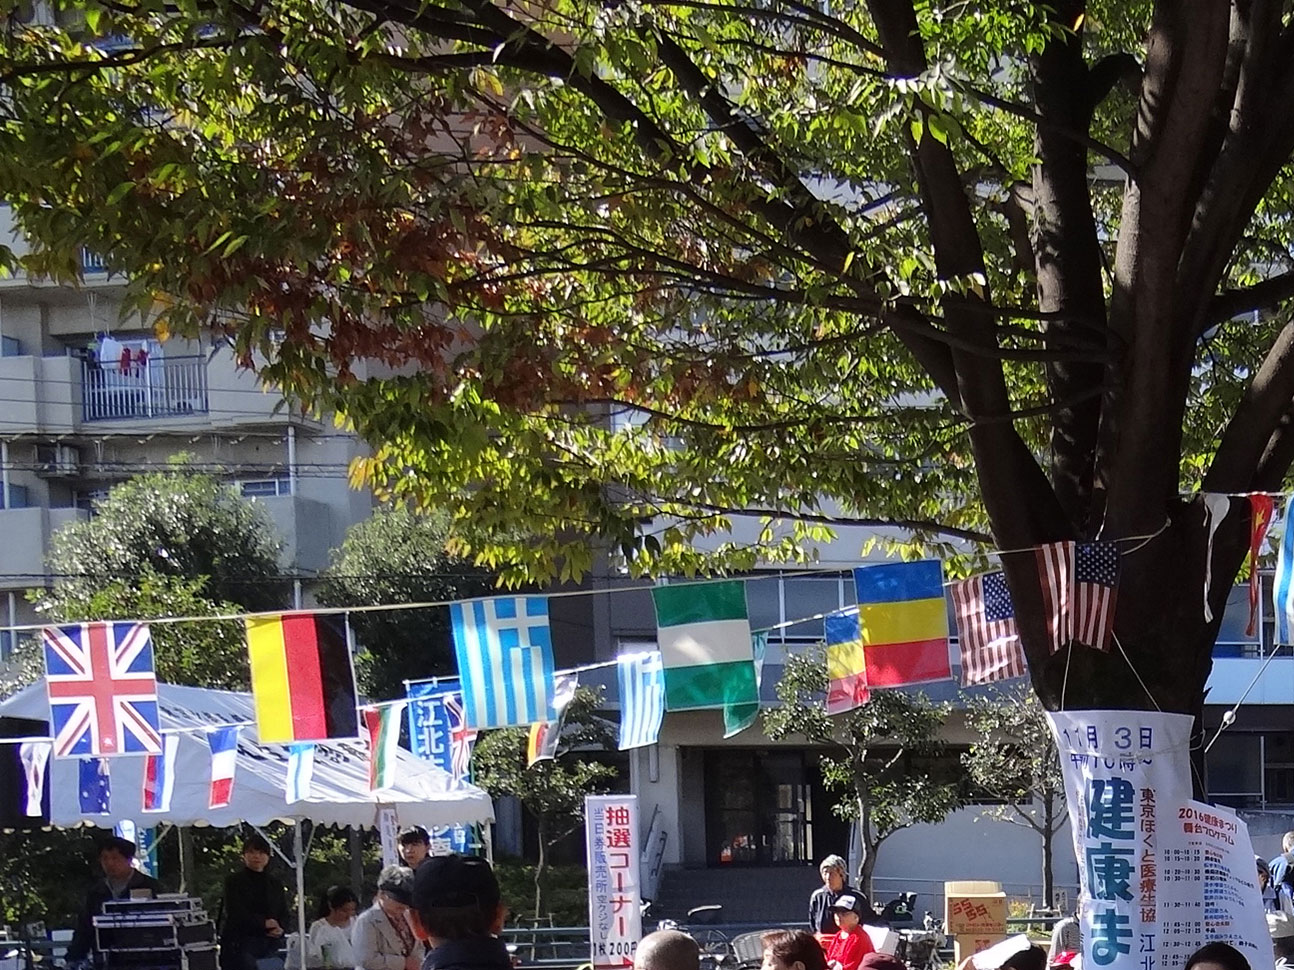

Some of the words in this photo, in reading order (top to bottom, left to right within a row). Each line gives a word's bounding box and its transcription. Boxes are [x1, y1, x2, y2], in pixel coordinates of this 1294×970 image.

[606, 806, 632, 937] 抽選コーナー
[1139, 788, 1156, 924] 東京ほくと医療生協
